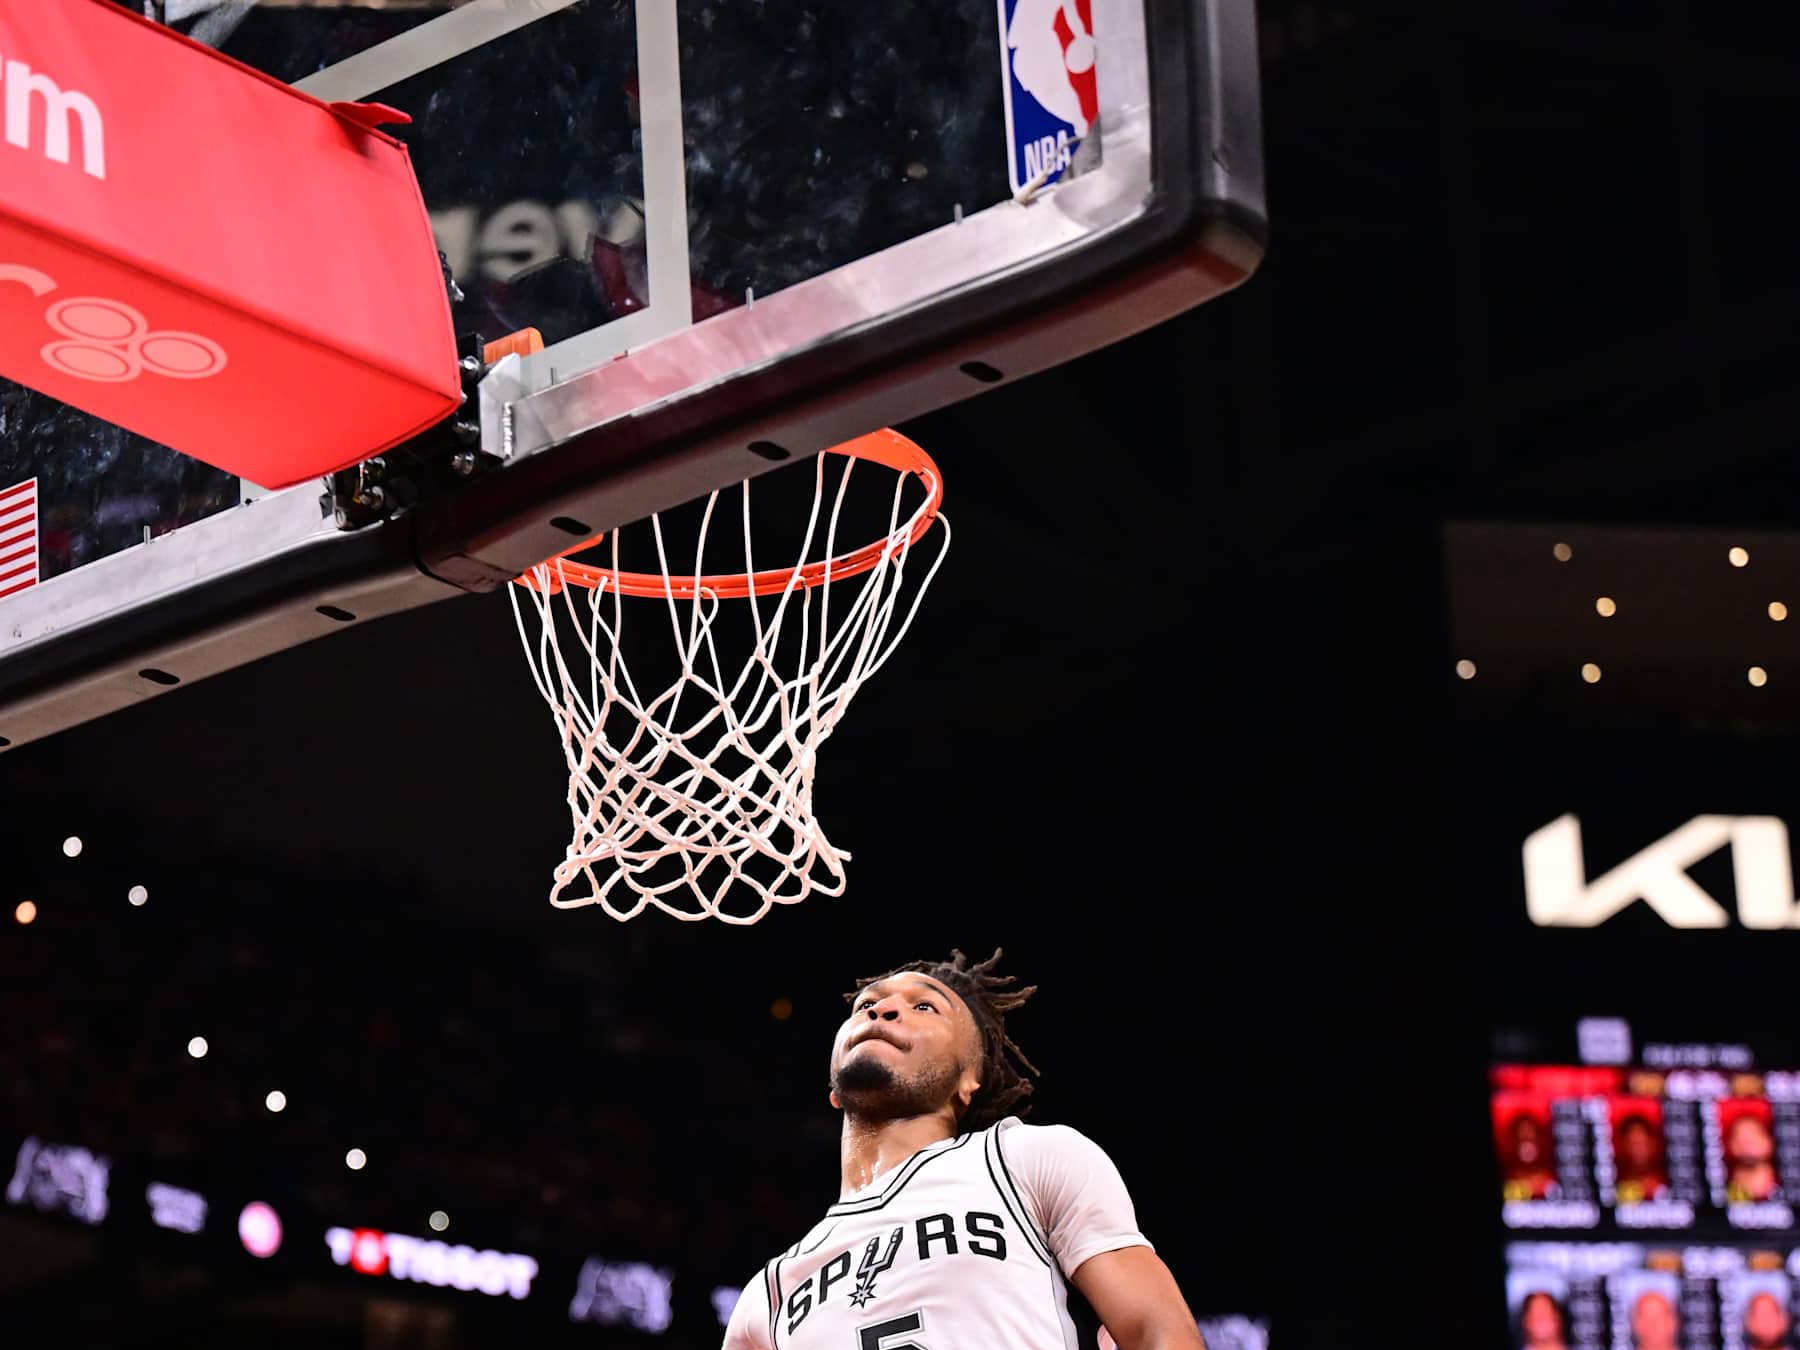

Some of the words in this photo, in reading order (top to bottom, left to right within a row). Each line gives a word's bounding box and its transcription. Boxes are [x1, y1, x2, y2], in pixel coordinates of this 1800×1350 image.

[0, 53, 106, 181] m
[1024, 129, 1071, 182] NBA
[386, 1233, 538, 1300] TISSOT
[787, 1211, 1007, 1336] SPURS
